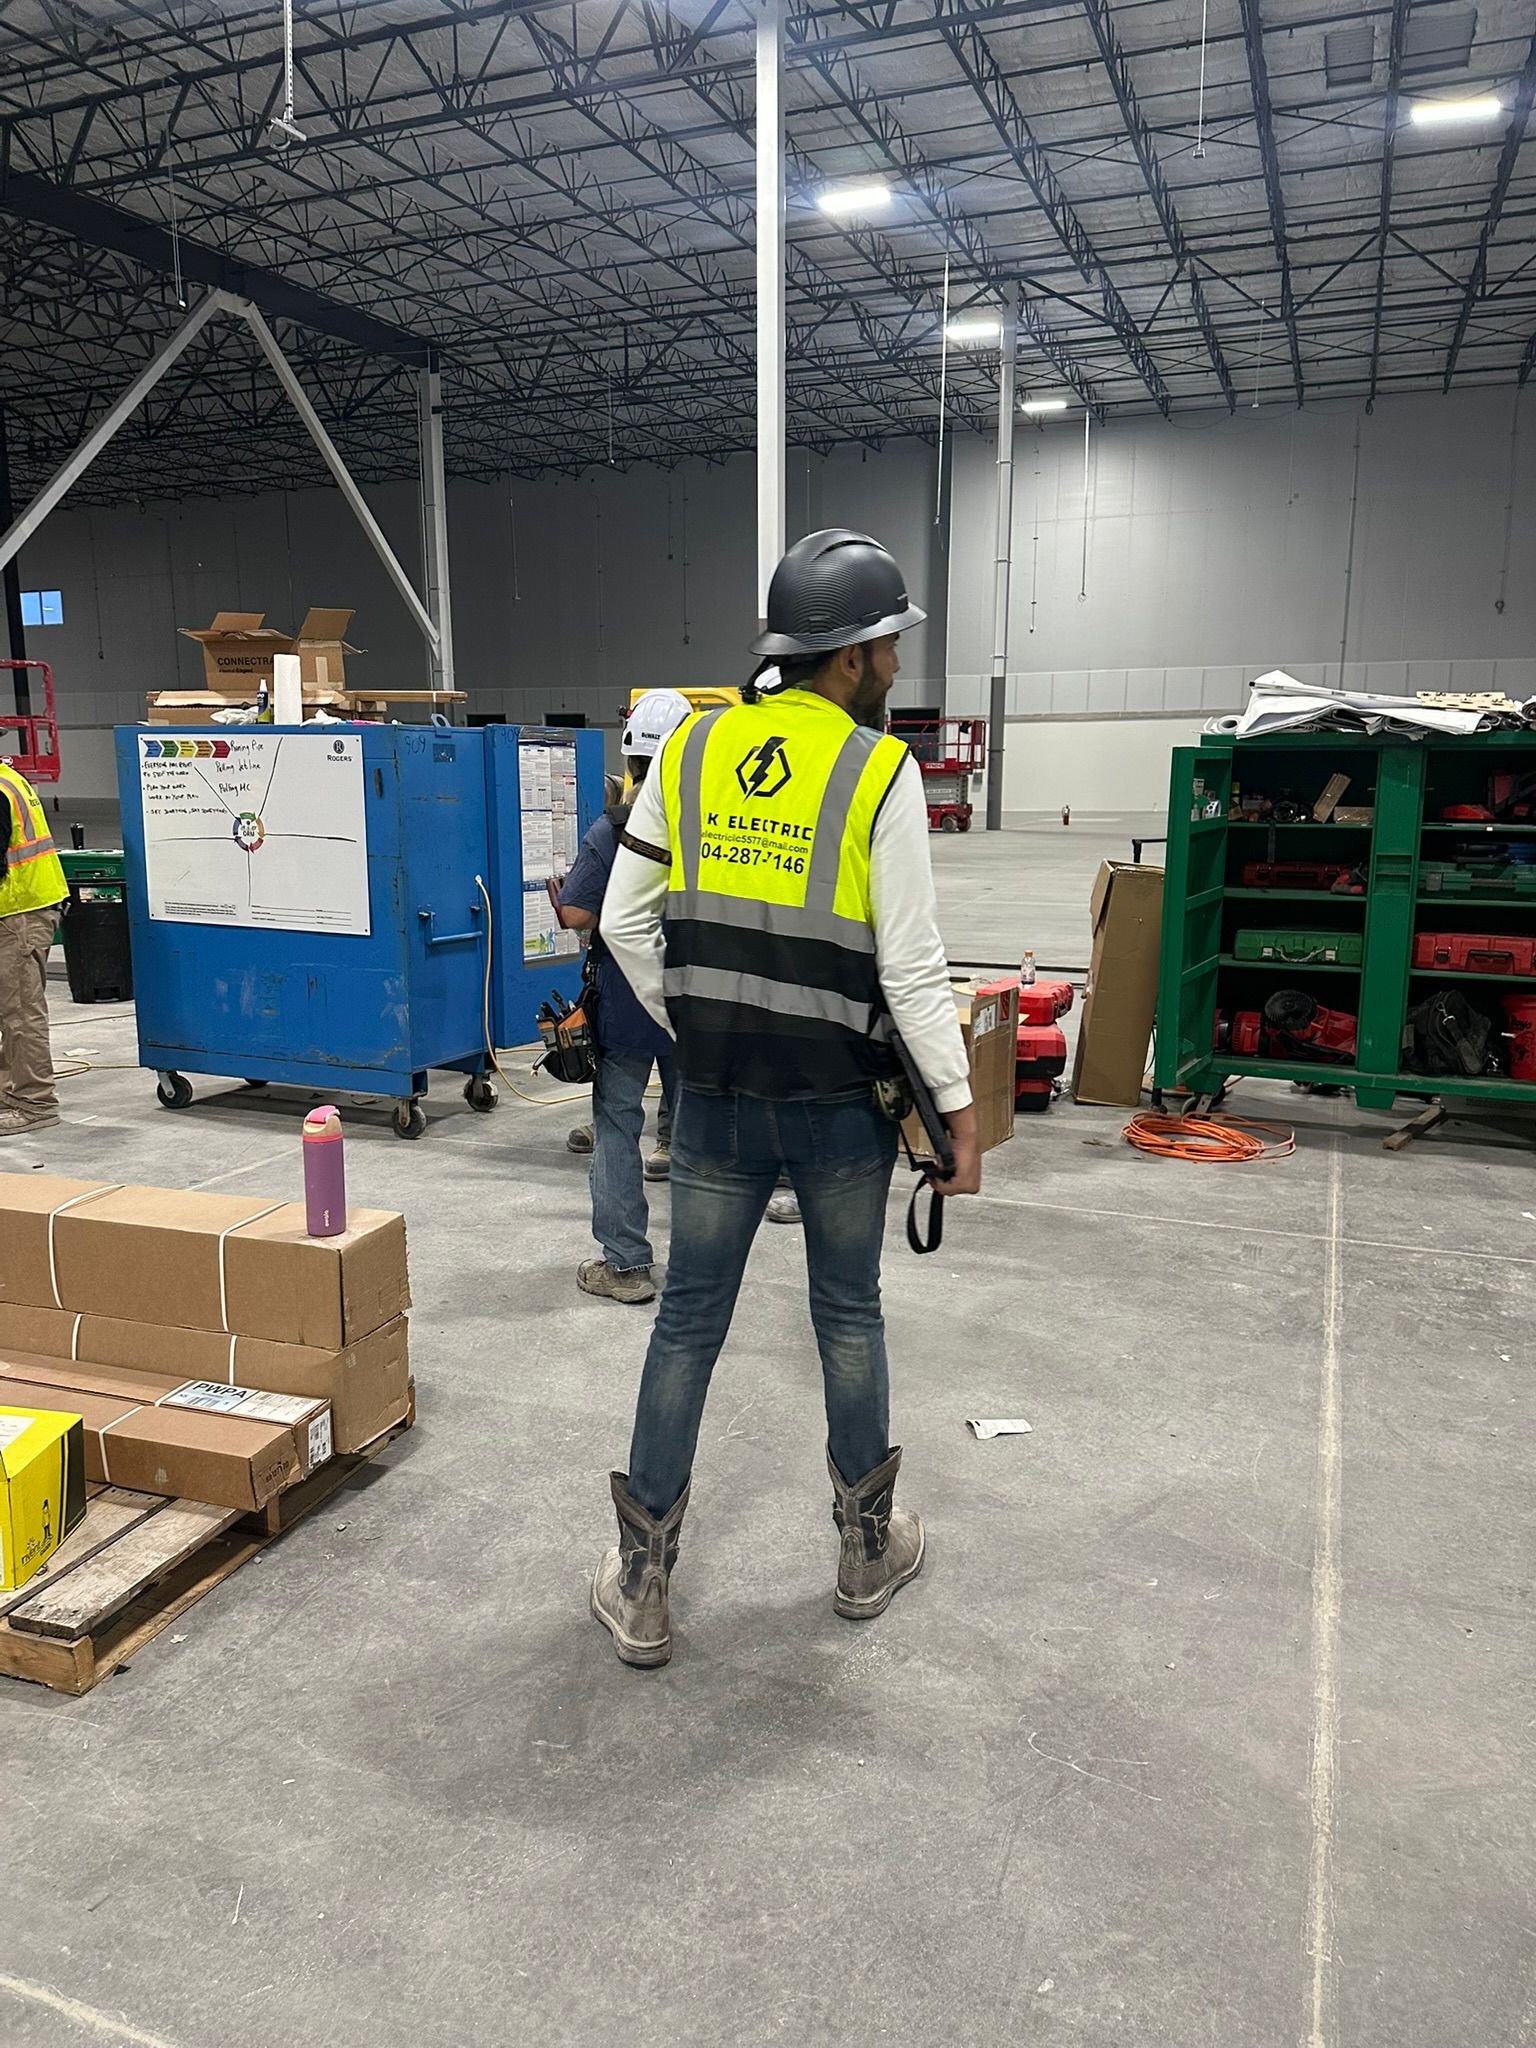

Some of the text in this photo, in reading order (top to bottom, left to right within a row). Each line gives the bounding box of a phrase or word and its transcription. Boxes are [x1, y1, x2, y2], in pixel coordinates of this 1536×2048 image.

[327, 754, 352, 762] ROGERS
[728, 815, 813, 841] ELECTRIC
[192, 1382, 248, 1399] PWPA
